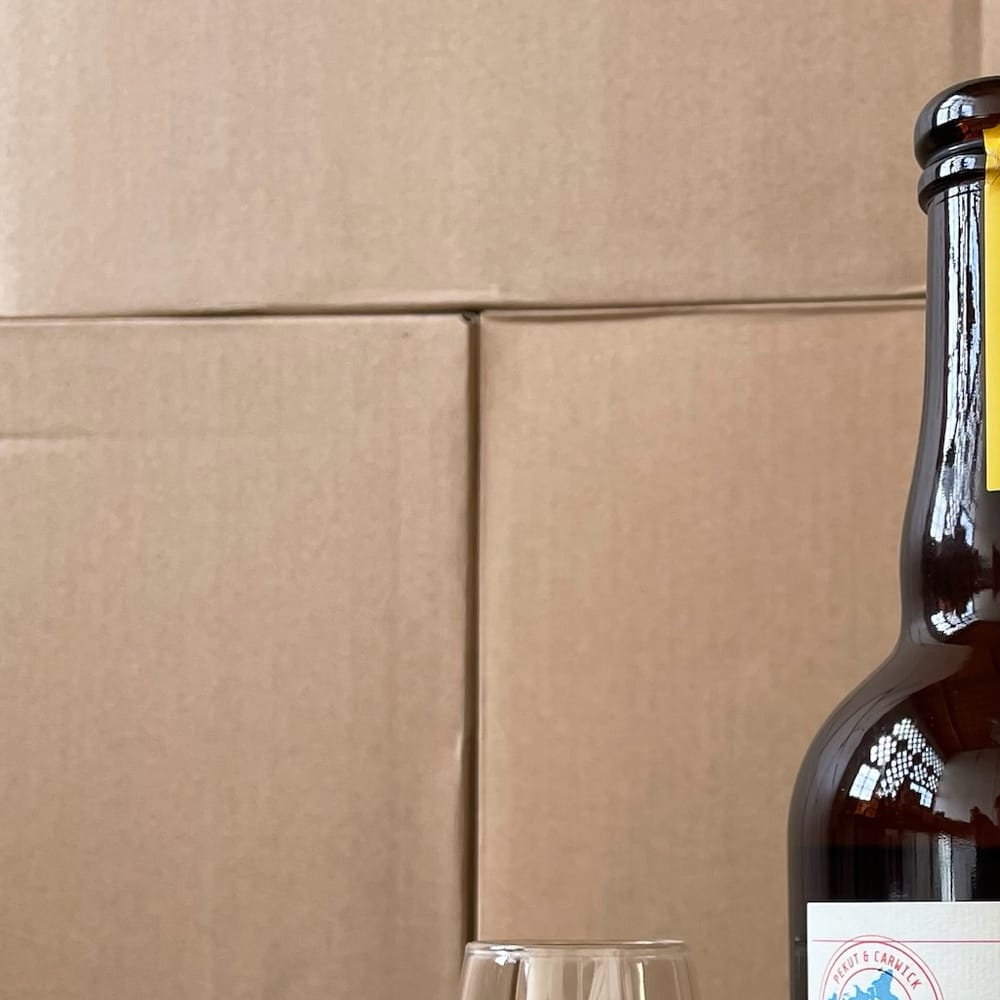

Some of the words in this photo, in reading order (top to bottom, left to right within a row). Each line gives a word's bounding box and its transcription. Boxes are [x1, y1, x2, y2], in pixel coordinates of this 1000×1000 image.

[833, 952, 859, 984] PEKUT
[863, 950, 870, 962] &
[874, 950, 922, 990] CARWICK
